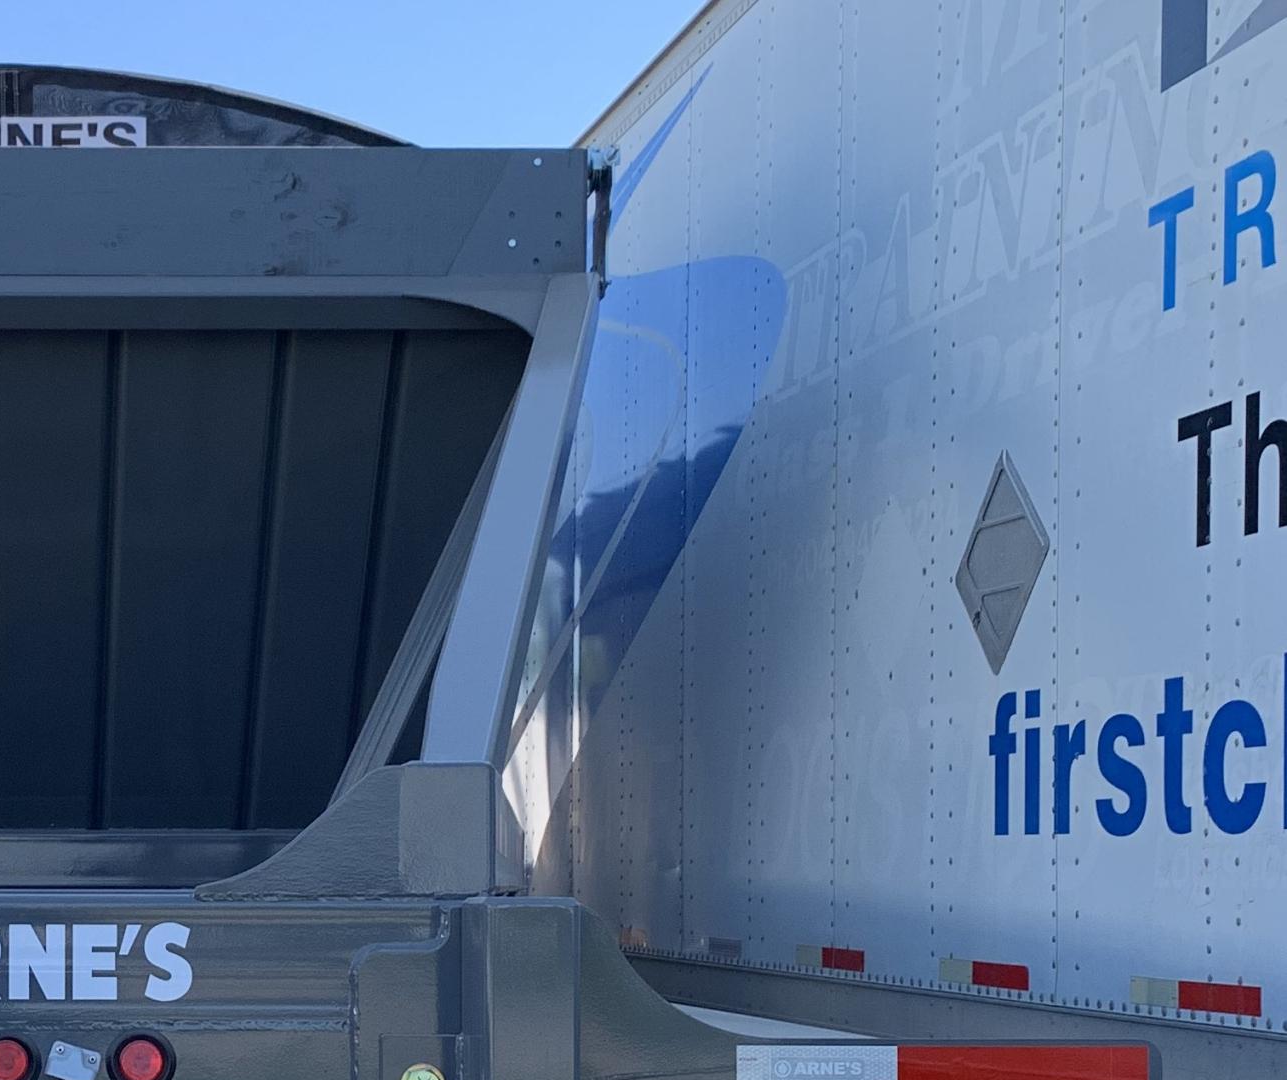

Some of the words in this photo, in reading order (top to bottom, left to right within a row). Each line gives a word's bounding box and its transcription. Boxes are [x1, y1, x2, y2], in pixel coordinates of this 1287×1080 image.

[1178, 391, 1287, 547] Th
[988, 652, 1287, 838] firstc
[794, 1061, 863, 1076] ARNE'S
